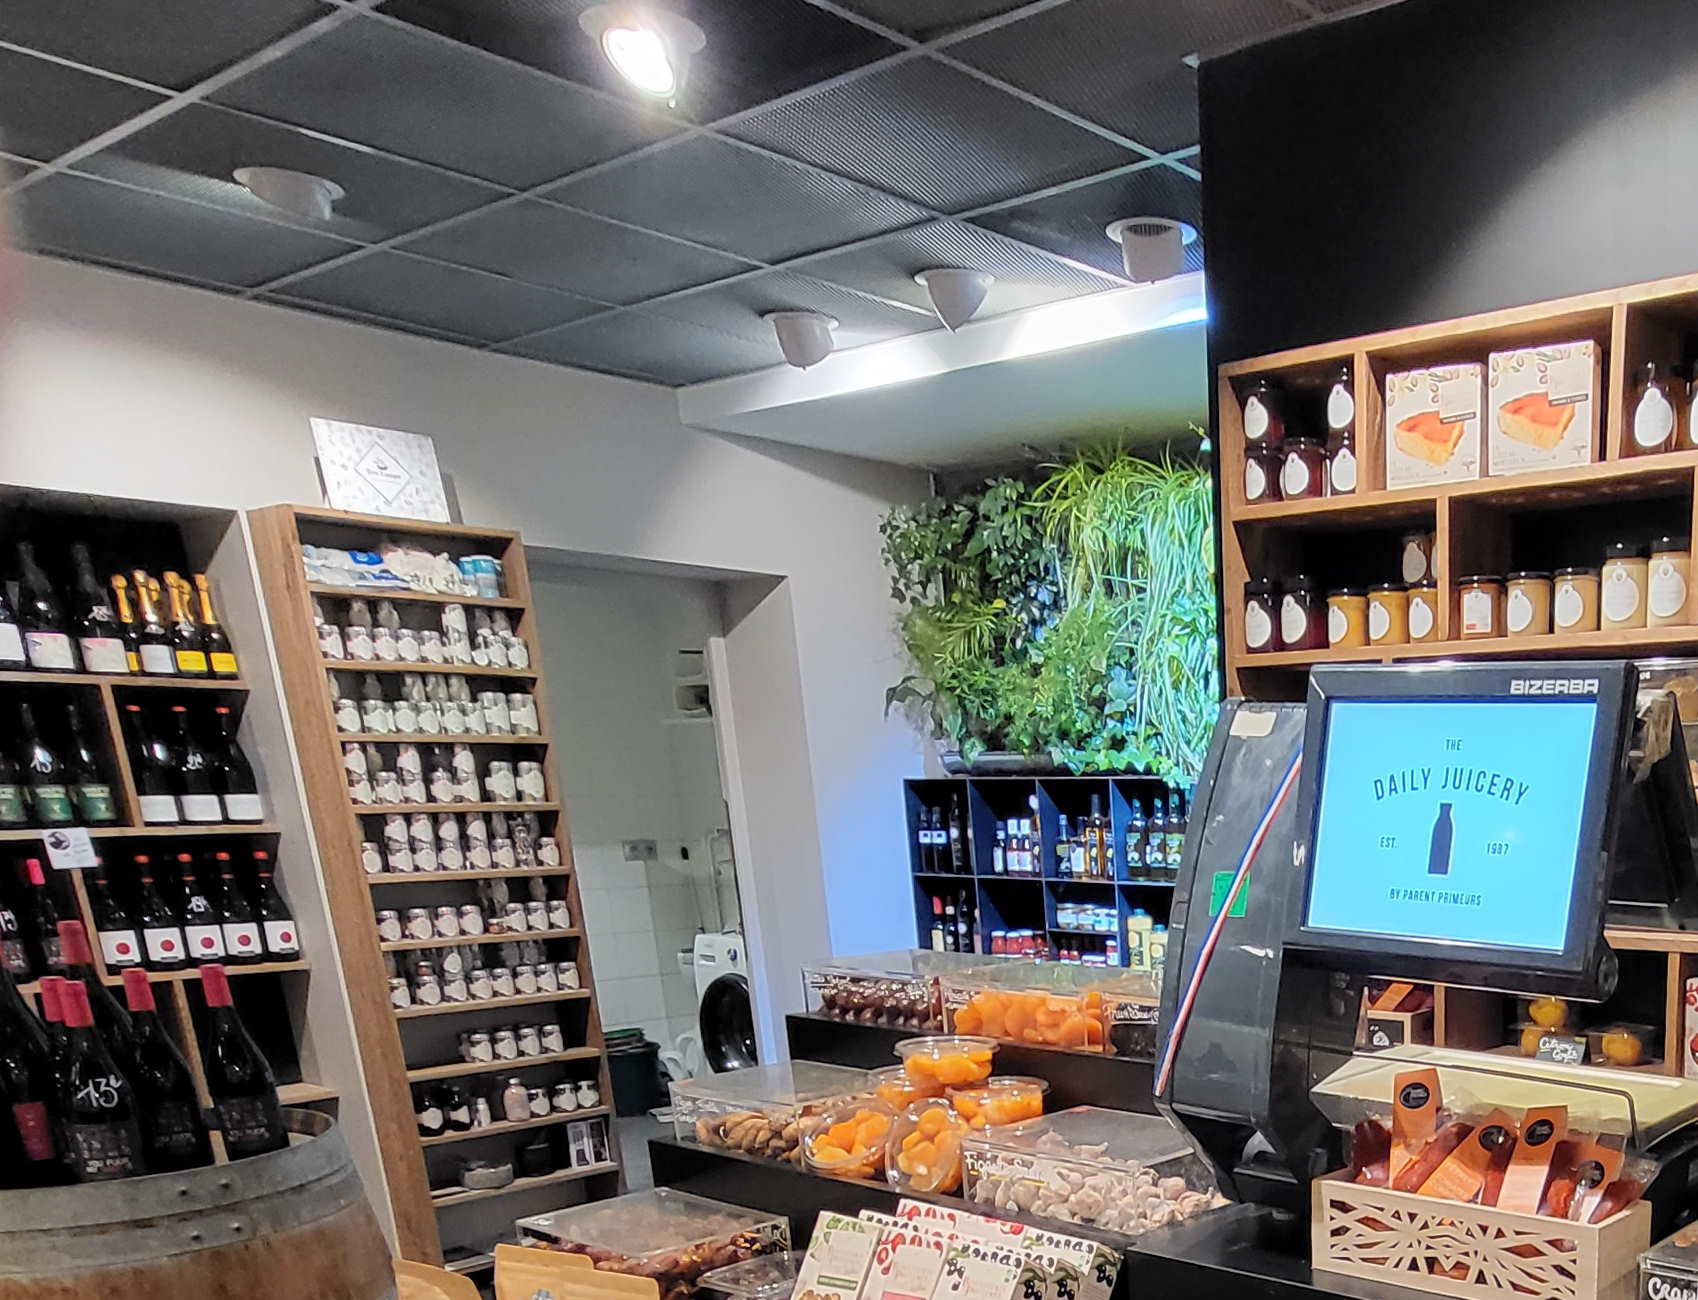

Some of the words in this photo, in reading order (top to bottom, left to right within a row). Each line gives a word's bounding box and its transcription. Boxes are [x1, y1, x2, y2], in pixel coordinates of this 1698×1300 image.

[1510, 678, 1599, 695] BIZERBA
[1445, 739, 1463, 751] THE
[1373, 767, 1433, 801] DAILY
[1441, 767, 1530, 806] JUICERY
[1390, 888, 1400, 900] BY
[1402, 889, 1436, 903] PARENT
[1437, 891, 1482, 906] PRIMEURS
